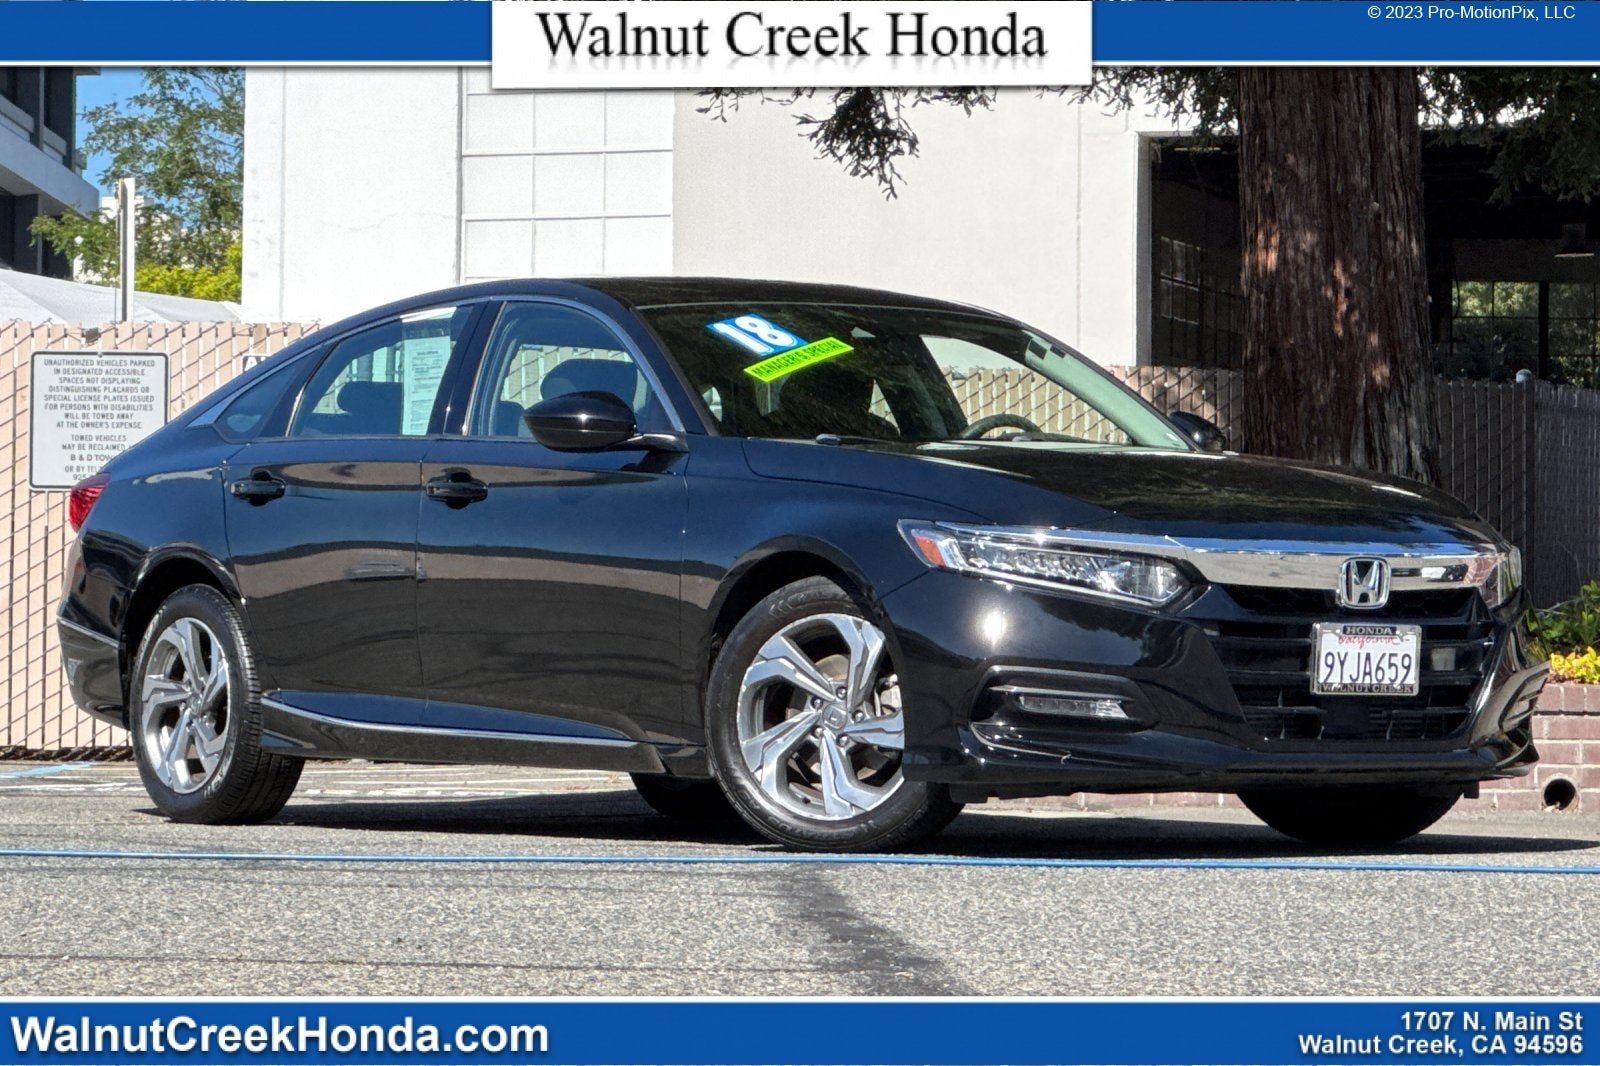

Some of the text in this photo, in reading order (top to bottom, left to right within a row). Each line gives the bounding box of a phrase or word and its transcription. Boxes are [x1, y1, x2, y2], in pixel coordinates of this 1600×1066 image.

[712, 316, 798, 354] 18
[44, 359, 95, 367] UNAUTHORIZED
[96, 359, 128, 367] VEHICLES
[751, 350, 809, 377] MANAGER'S
[62, 368, 103, 376] DESIGNATED
[105, 368, 145, 376] ACCESSIBLE
[100, 377, 140, 385] DISPLAYING
[44, 394, 71, 402] SPECIAL
[103, 395, 128, 403] PLATES
[130, 395, 155, 403] ISSUED
[60, 403, 91, 411] PERSONS
[81, 421, 110, 429] OWNER'S
[111, 421, 142, 429] EXPENSE
[95, 434, 127, 442] VEHICLES
[61, 443, 75, 451] MAY
[77, 443, 86, 451] BE
[88, 443, 126, 451] RECLAIMED
[95, 454, 114, 462] TOW
[64, 465, 74, 473] OR
[75, 465, 85, 473] BY
[1346, 626, 1393, 635] HONDA
[1323, 651, 1413, 684] 9YJA659
